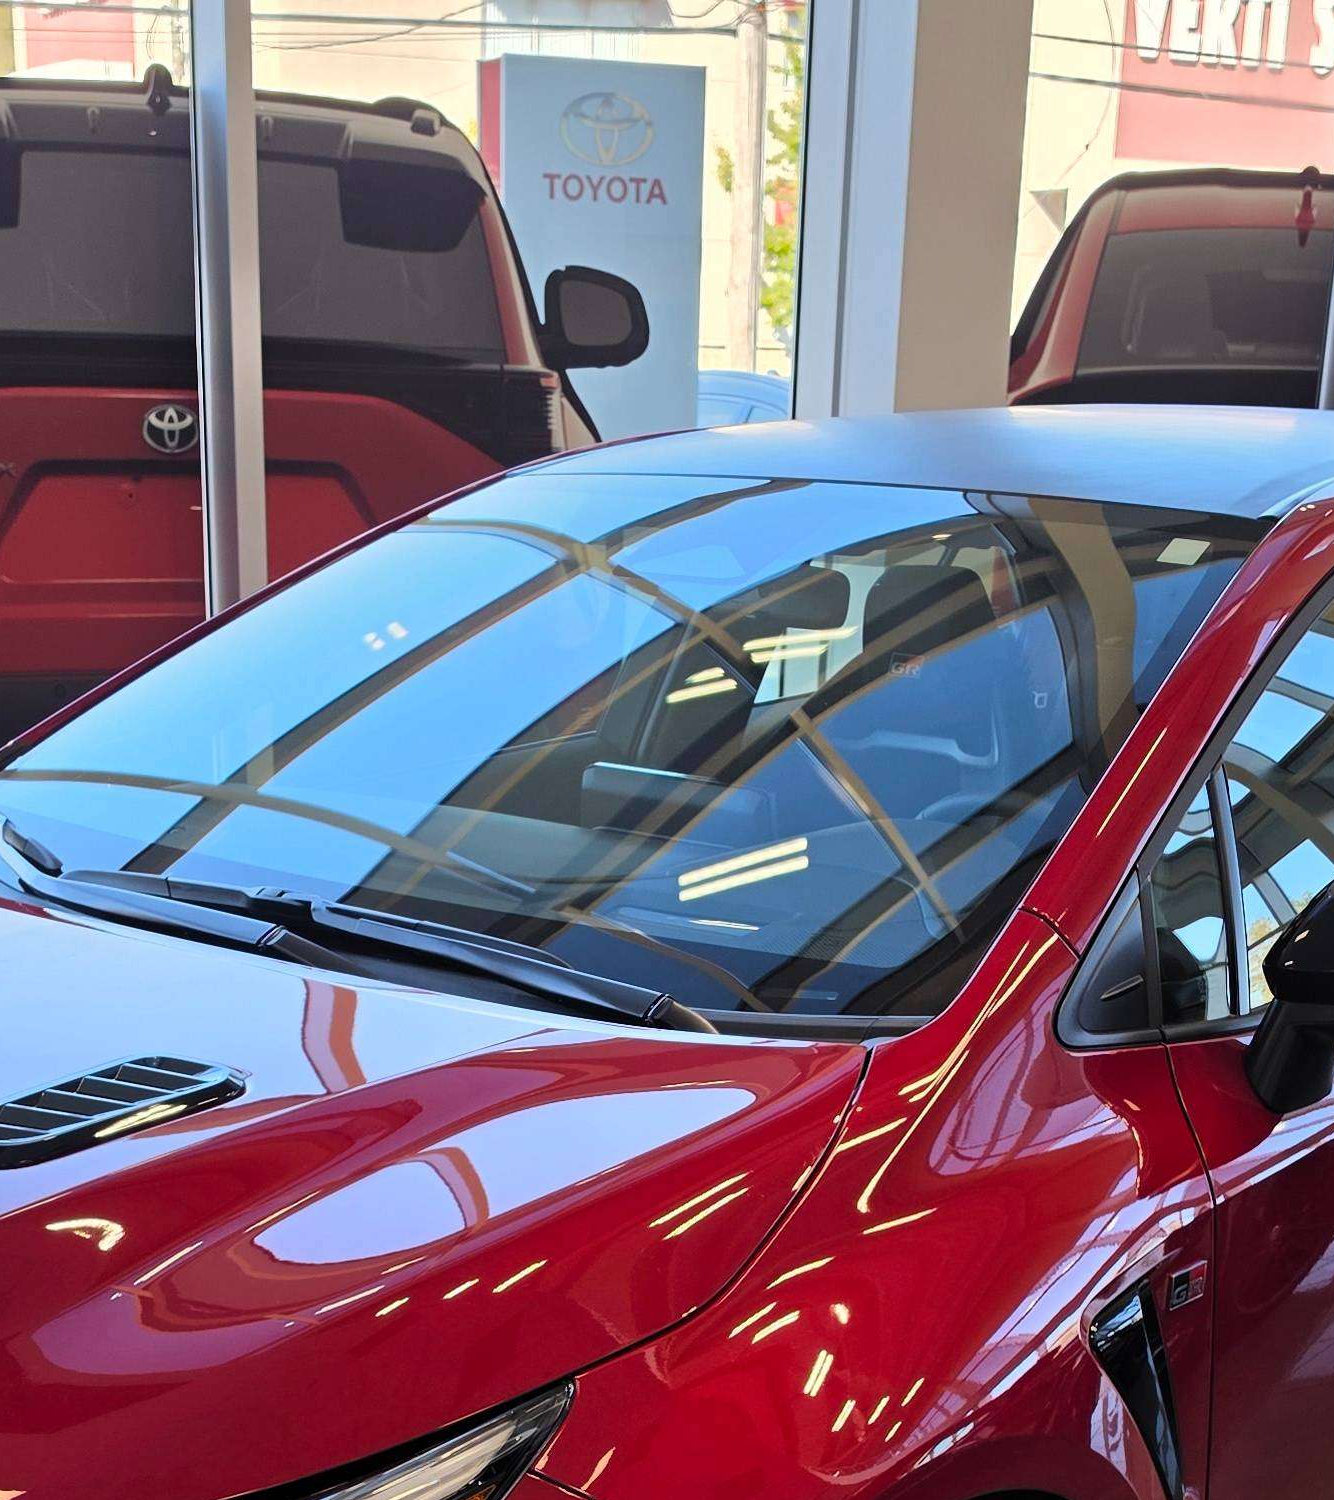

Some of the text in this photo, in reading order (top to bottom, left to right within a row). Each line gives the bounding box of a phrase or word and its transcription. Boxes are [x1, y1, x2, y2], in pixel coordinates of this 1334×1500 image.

[542, 173, 668, 205] TOYOTA
[891, 661, 921, 677] GR
[1170, 1276, 1204, 1305] GR
